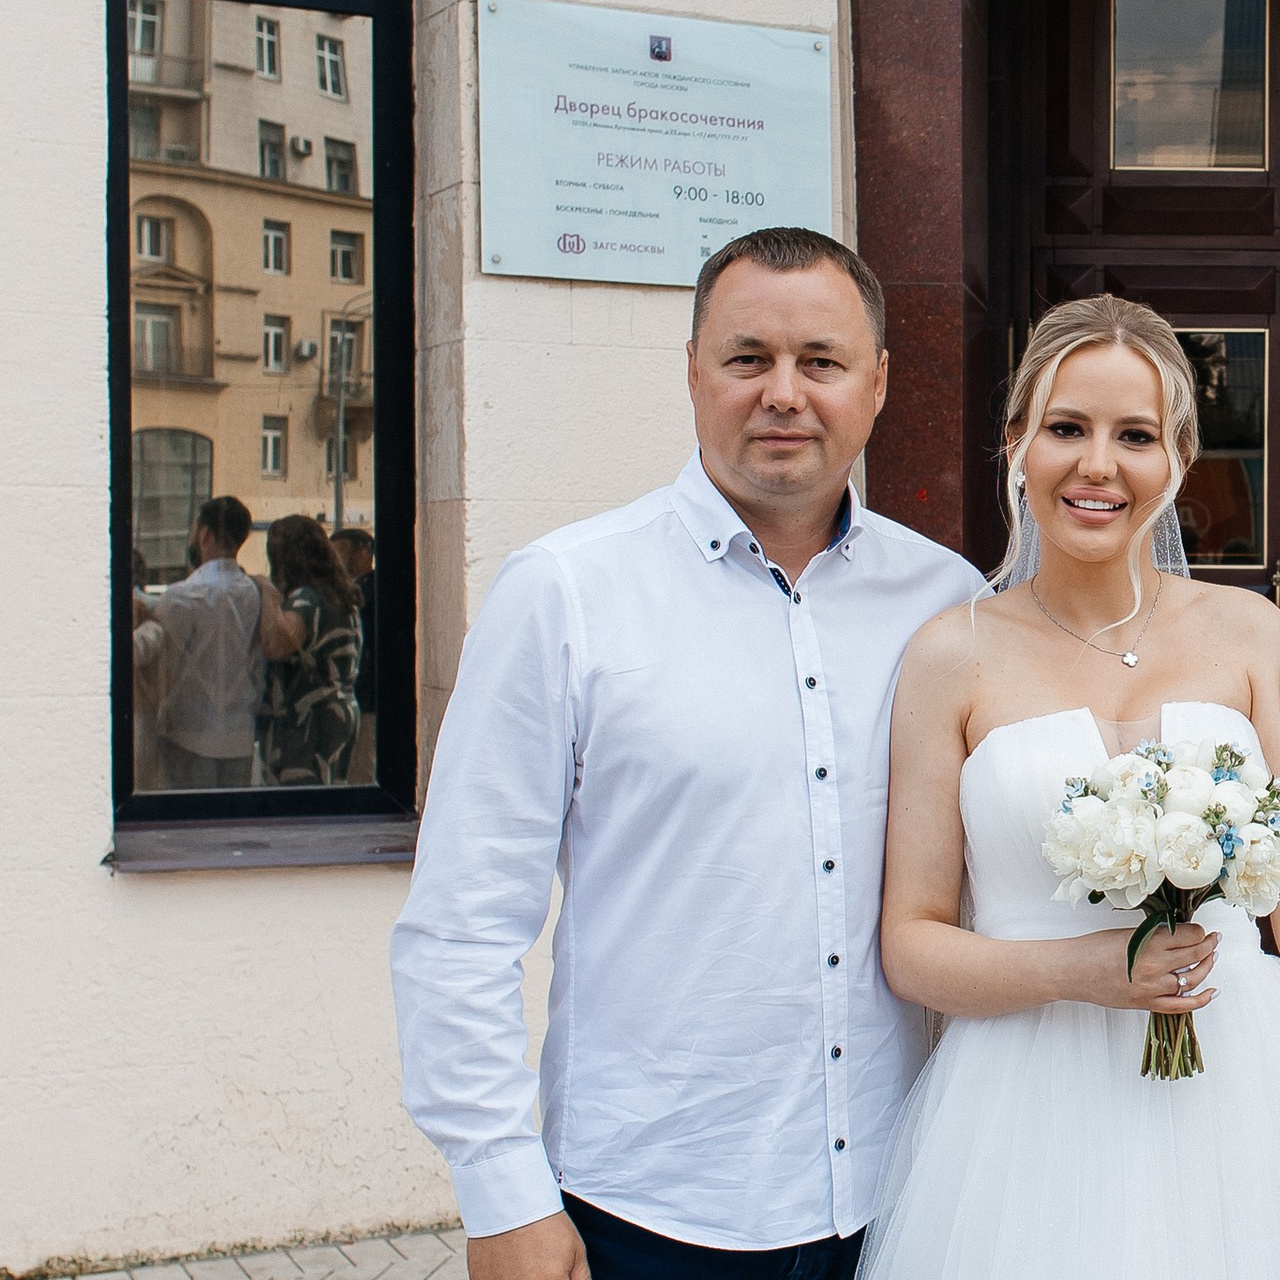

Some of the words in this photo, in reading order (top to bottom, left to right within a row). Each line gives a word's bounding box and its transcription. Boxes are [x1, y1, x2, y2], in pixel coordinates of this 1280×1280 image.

[554, 94, 622, 120] Дворец
[627, 100, 765, 131] бракосочетания
[597, 152, 658, 171] РЕЖИМ
[663, 158, 726, 177] РАБОТЫ
[555, 179, 587, 188] ВТОРНИК
[592, 182, 624, 191] СУББОТА
[673, 185, 708, 202] 9:00
[725, 189, 765, 207] 18:00
[609, 209, 660, 219] ПОНЕДЕЛЬНИК
[699, 217, 738, 225] ВЫХОДНОЙ
[592, 241, 618, 251] ЗАГС
[619, 243, 665, 255] МОСКВЫ
